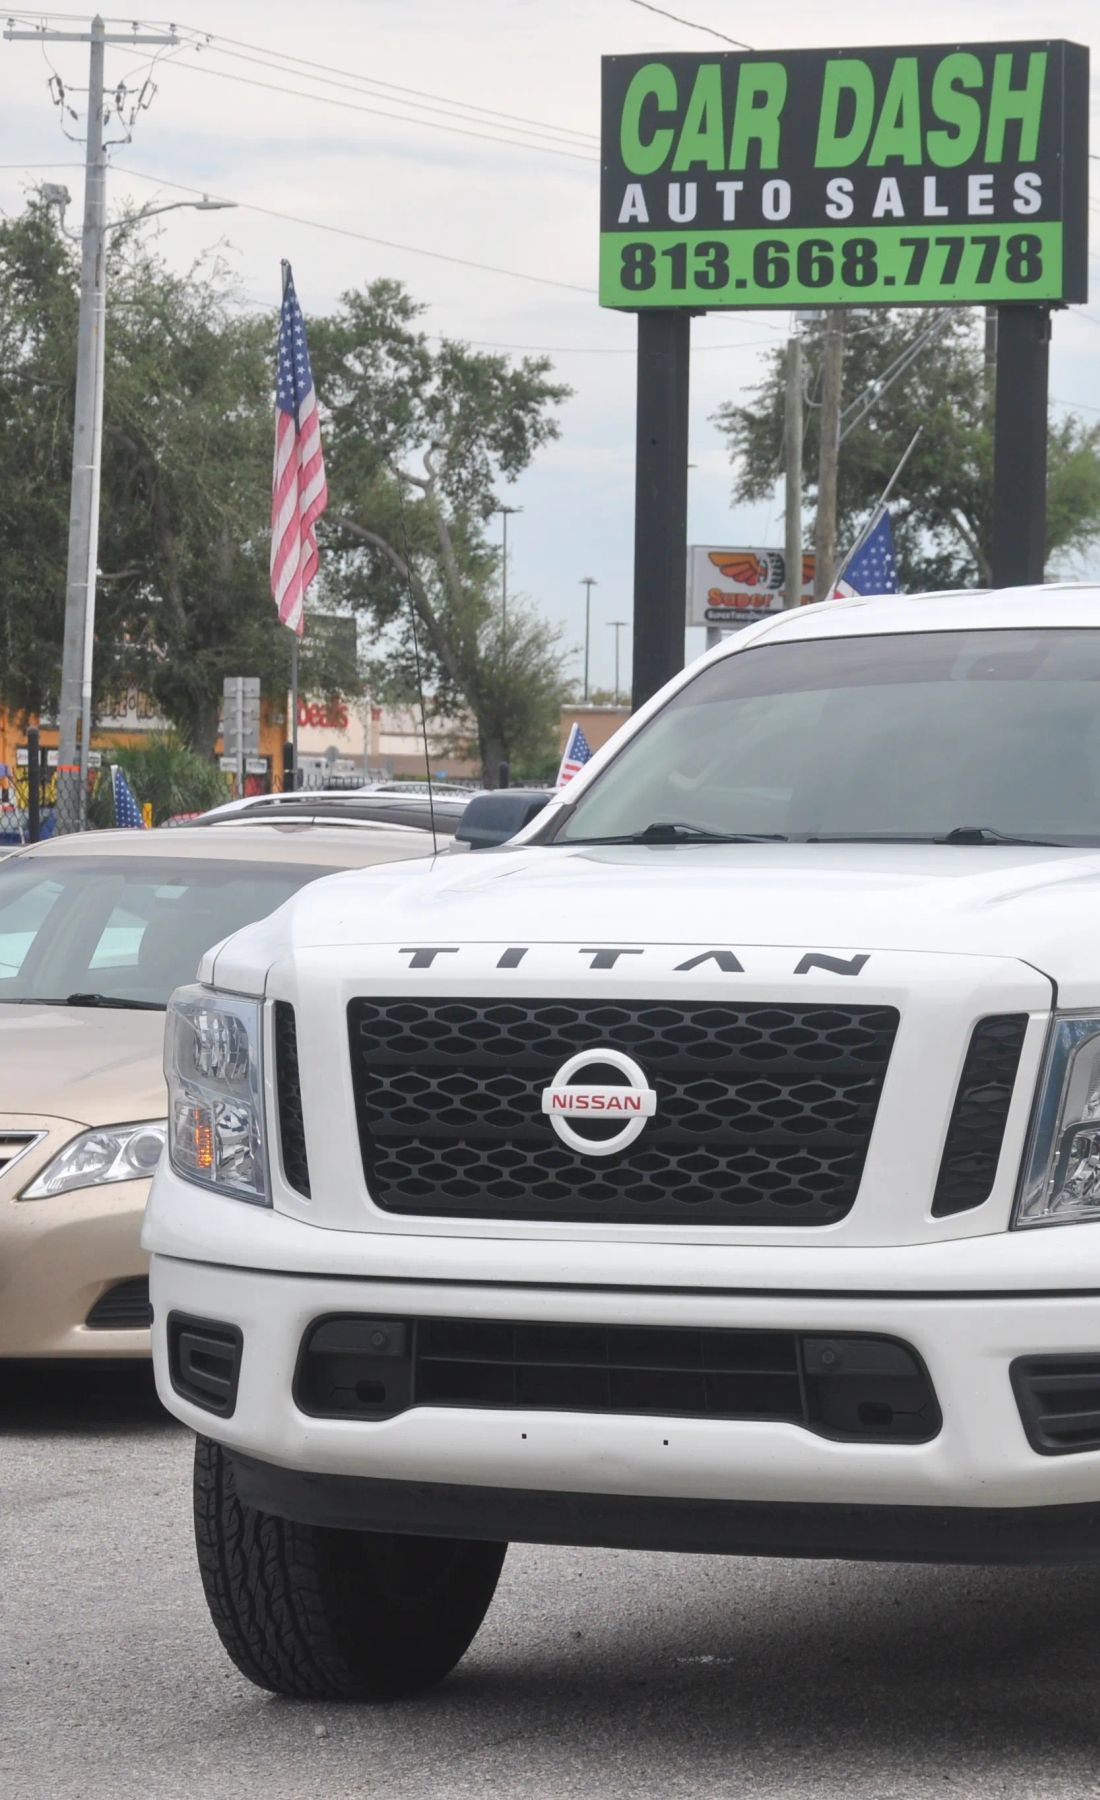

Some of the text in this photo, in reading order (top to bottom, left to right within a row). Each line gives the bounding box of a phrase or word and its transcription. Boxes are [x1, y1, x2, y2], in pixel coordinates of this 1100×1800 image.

[620, 51, 1048, 176] CAR DASH
[618, 171, 1043, 224] AUTO SALES
[619, 233, 1044, 292] 813.668.7778
[397, 946, 872, 977] TITAN
[552, 1094, 641, 1111] NISSAN
